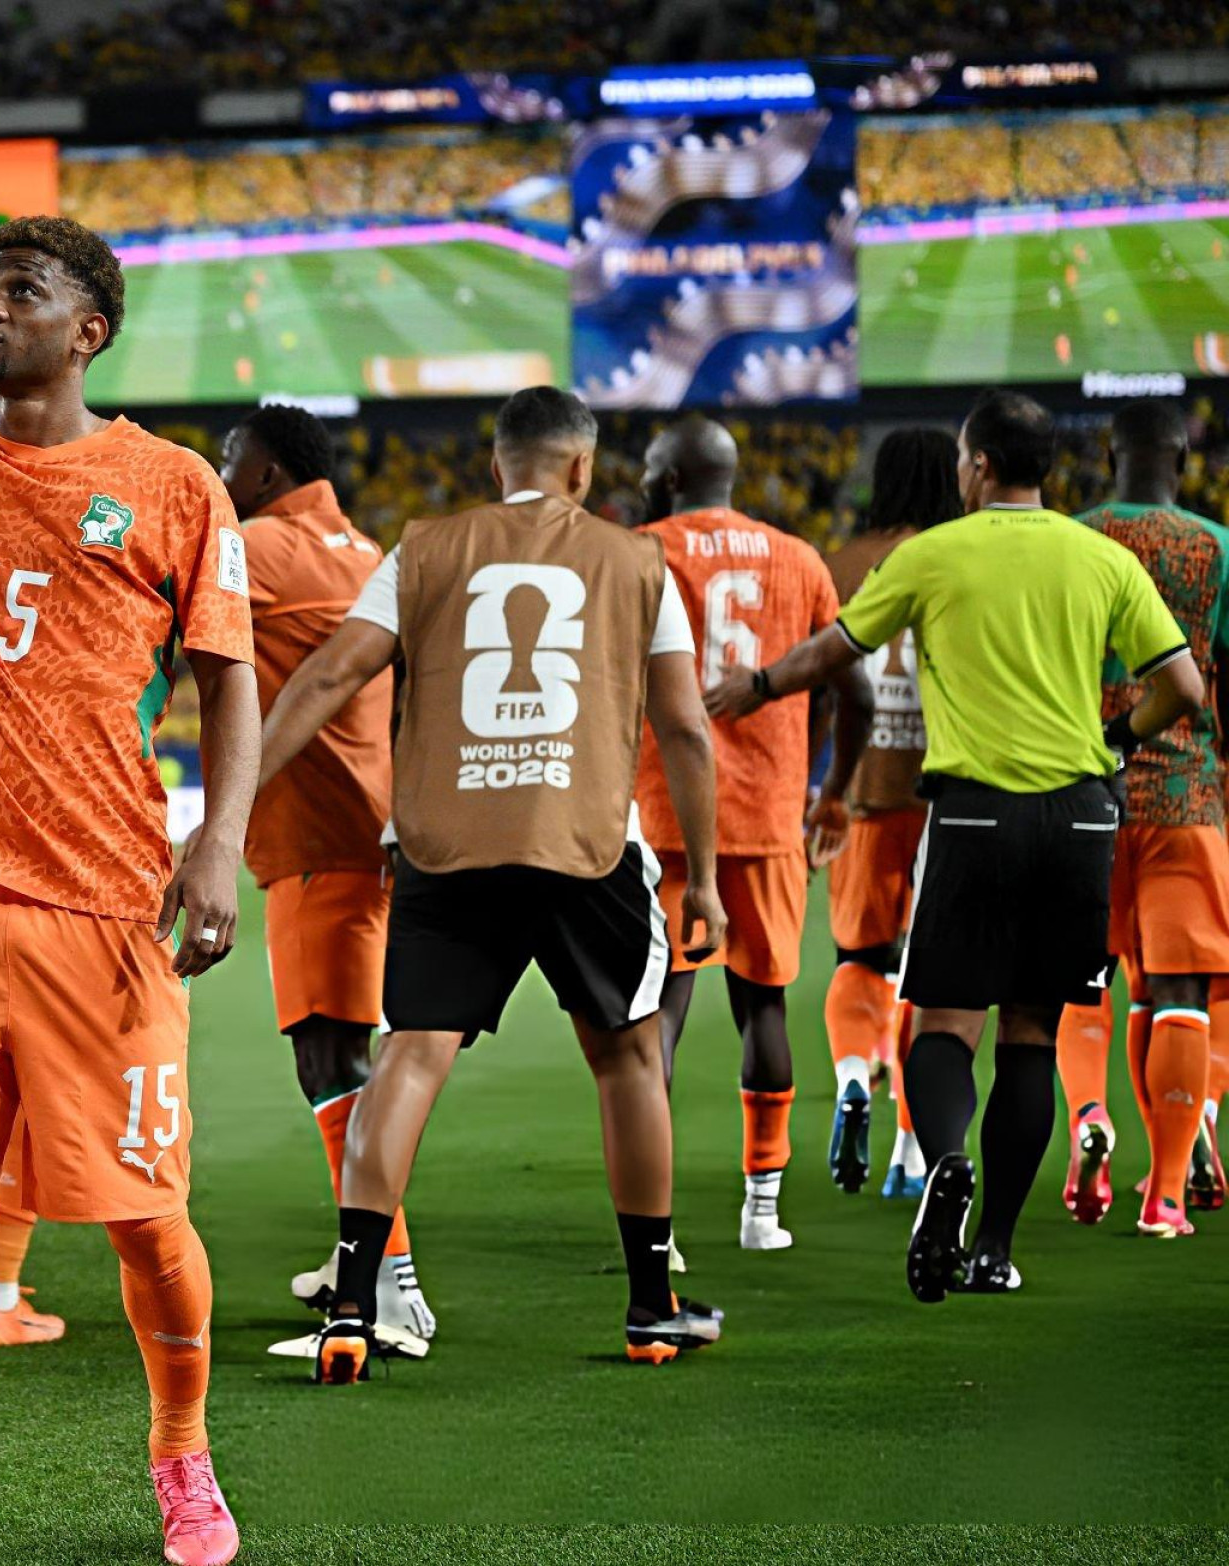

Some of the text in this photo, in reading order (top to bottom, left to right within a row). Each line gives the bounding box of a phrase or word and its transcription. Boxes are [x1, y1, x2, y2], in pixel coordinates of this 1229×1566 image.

[686, 529, 771, 558] FOFANA
[702, 569, 763, 690] 6
[495, 702, 546, 720] FIFA
[459, 741, 574, 762] WORLD CUP
[457, 760, 572, 789] 2026
[118, 1063, 180, 1147] 15
